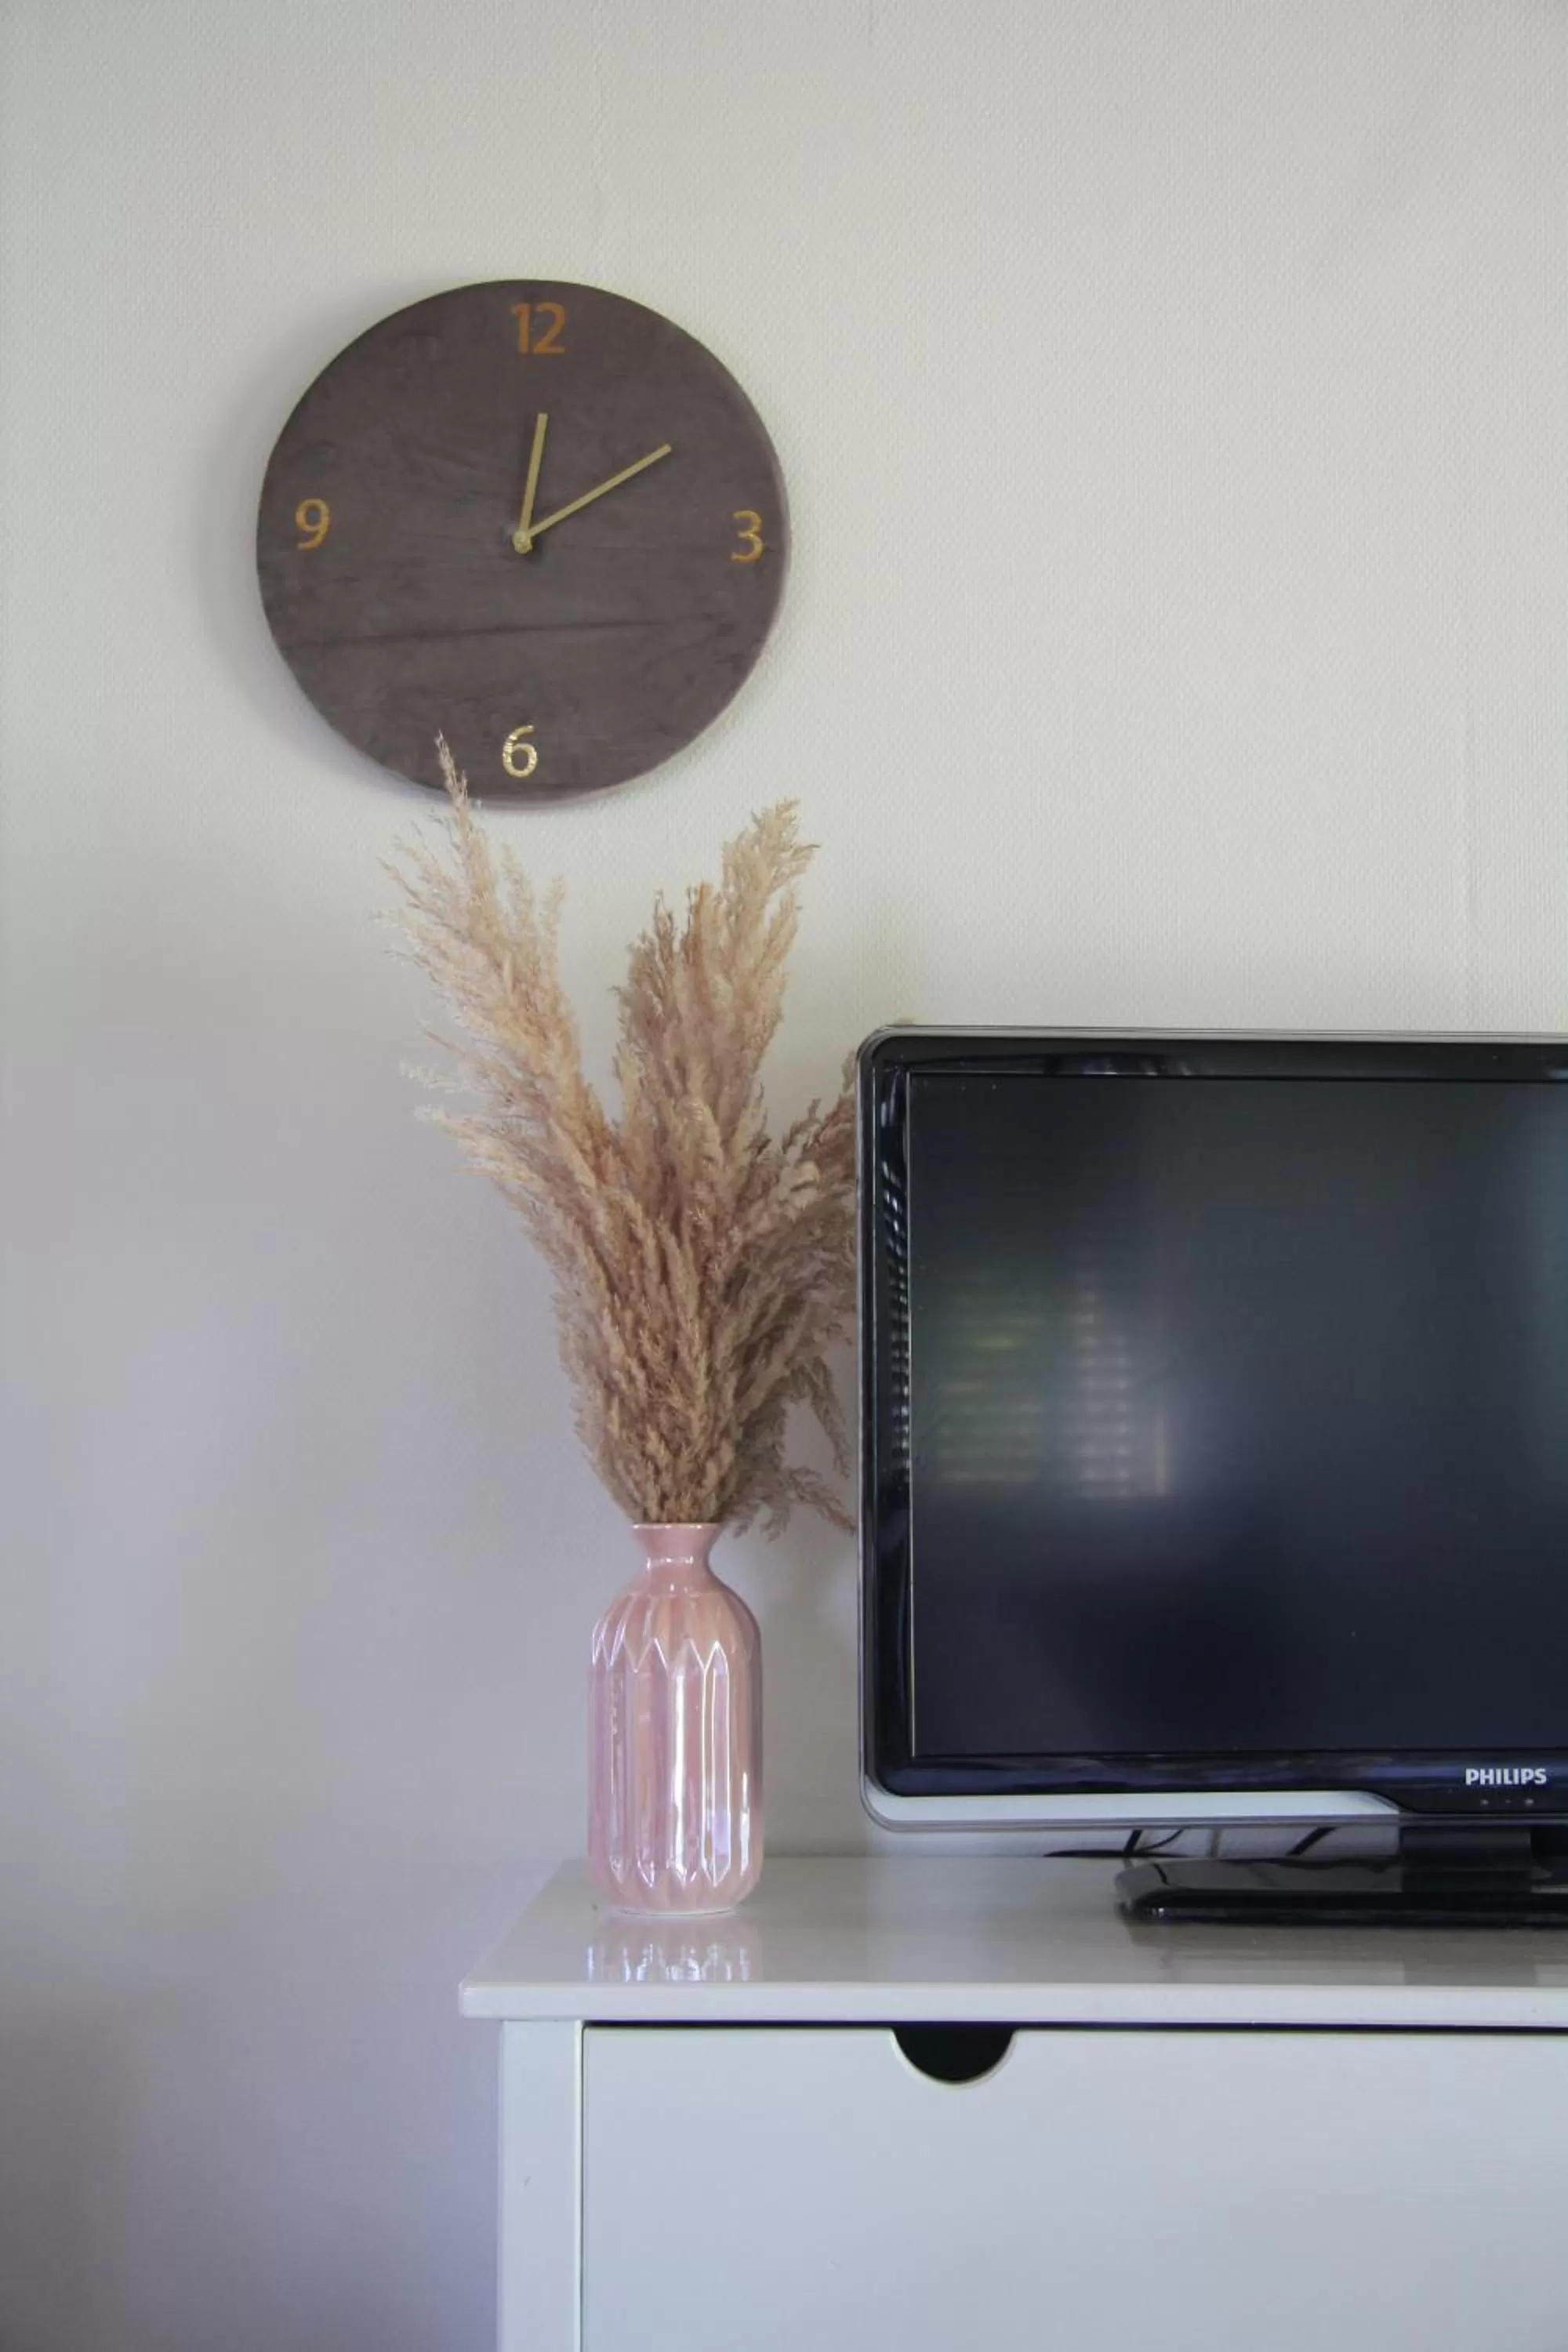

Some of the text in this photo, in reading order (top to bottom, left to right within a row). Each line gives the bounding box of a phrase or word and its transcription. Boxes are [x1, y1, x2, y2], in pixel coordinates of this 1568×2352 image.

[511, 302, 566, 354] 12
[295, 498, 331, 550] 9
[730, 510, 764, 563] 3
[501, 724, 539, 778] 6
[1465, 1768, 1547, 1785] PHILIPS
